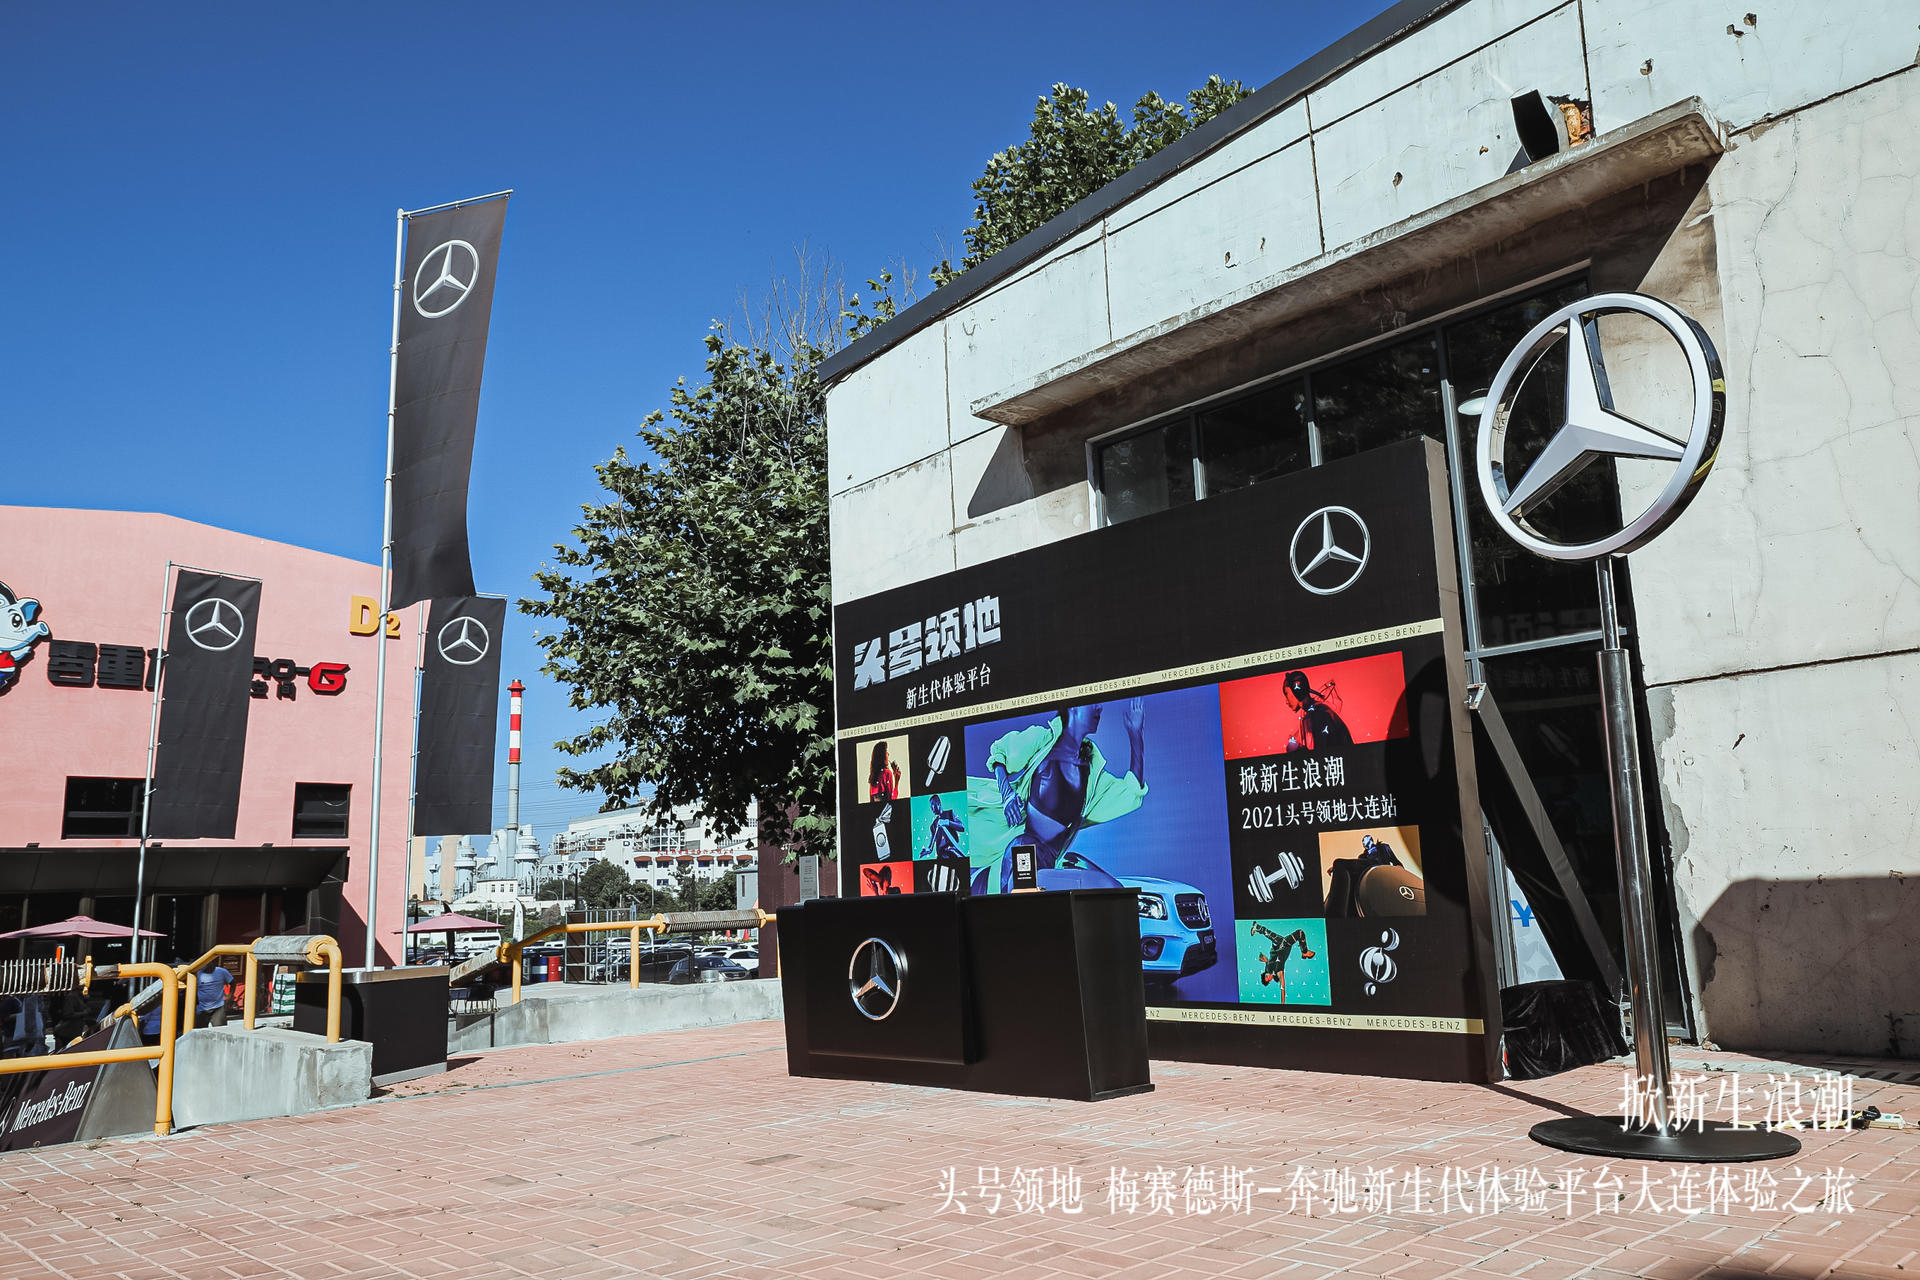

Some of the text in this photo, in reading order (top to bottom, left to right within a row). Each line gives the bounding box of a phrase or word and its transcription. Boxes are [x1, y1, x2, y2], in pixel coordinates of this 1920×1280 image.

[350, 595, 401, 640] D2
[854, 595, 1001, 691] 头号领地
[906, 662, 991, 710] 新生代体验平台
[950, 702, 1004, 718] MERCEDES-BENZ
[1011, 690, 1069, 707] MERCEDES-BENZ
[1078, 677, 1142, 694] MERCEDES-BENZ
[1161, 661, 1232, 680] MERCEDES-BENZ
[1243, 645, 1322, 665] MERCEDES-BENZ
[1335, 625, 1423, 649] MERCEDES-BENZ
[1239, 755, 1345, 796] 掀新生浪潮
[1241, 793, 1397, 829] 2021头号领地大连站
[1181, 1011, 1256, 1022] MERCEDES-BENZ
[1268, 1015, 1352, 1027] MERCEDES-BENZ
[1366, 1018, 1460, 1031] MERCEDES-BENZ
[9, 1080, 91, 1133] Mercedes-Benz
